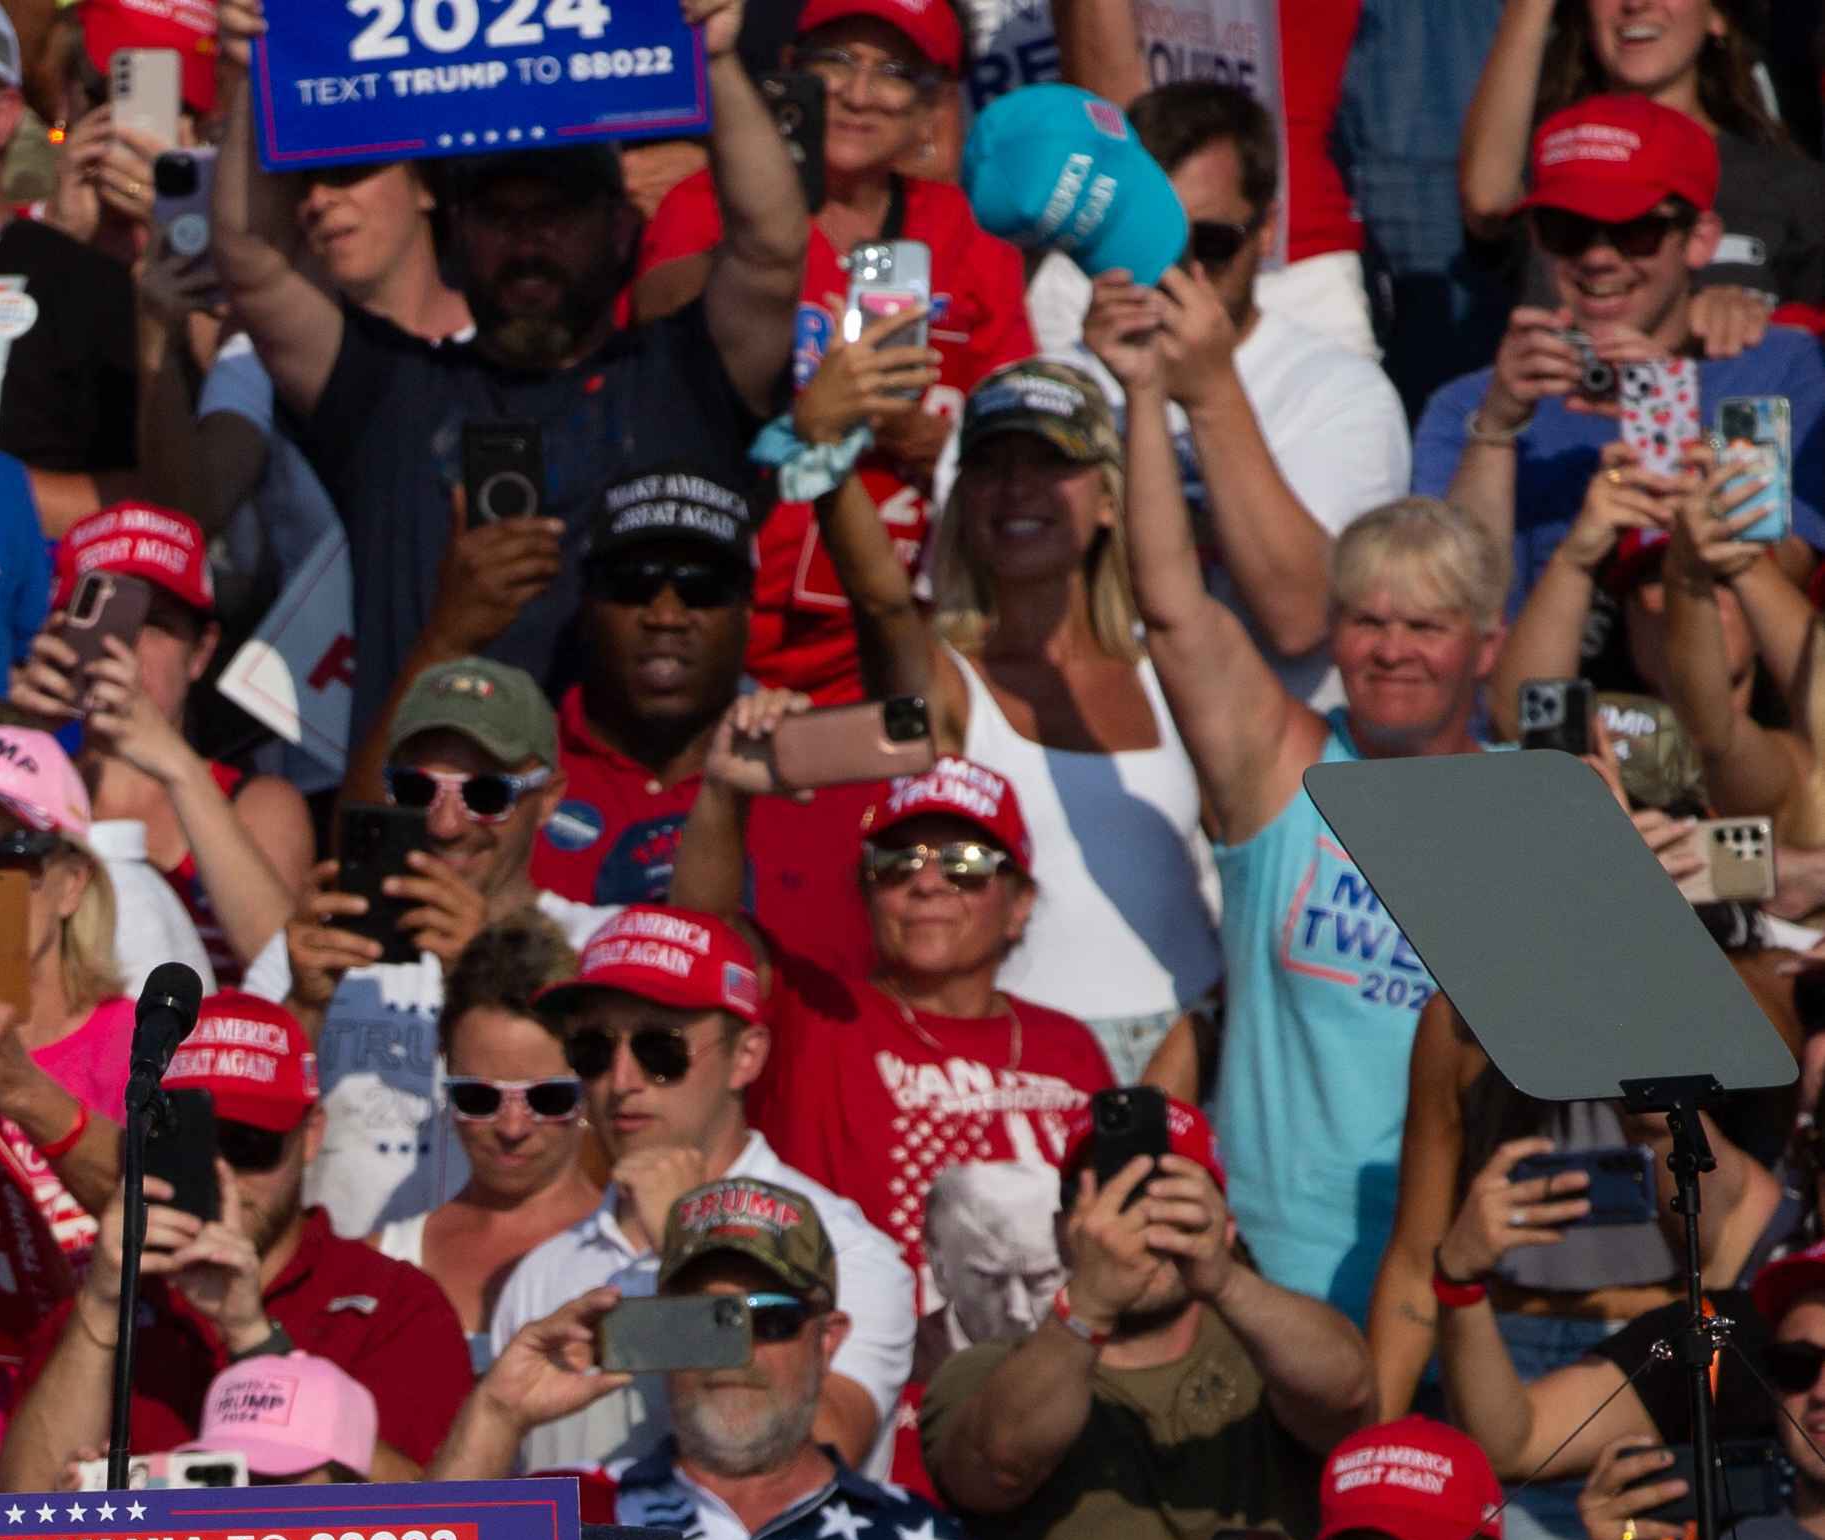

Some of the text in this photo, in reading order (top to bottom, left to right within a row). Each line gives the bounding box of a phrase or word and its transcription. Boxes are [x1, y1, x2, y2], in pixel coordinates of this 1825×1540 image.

[350, 0, 612, 60] 2024
[294, 45, 674, 106] TEXT TRUMP TO 88022
[627, 942, 695, 977] AGAIN
[199, 1017, 290, 1056] AMERICA
[215, 1050, 278, 1083] AGAIN
[679, 1188, 802, 1226] TRUMP
